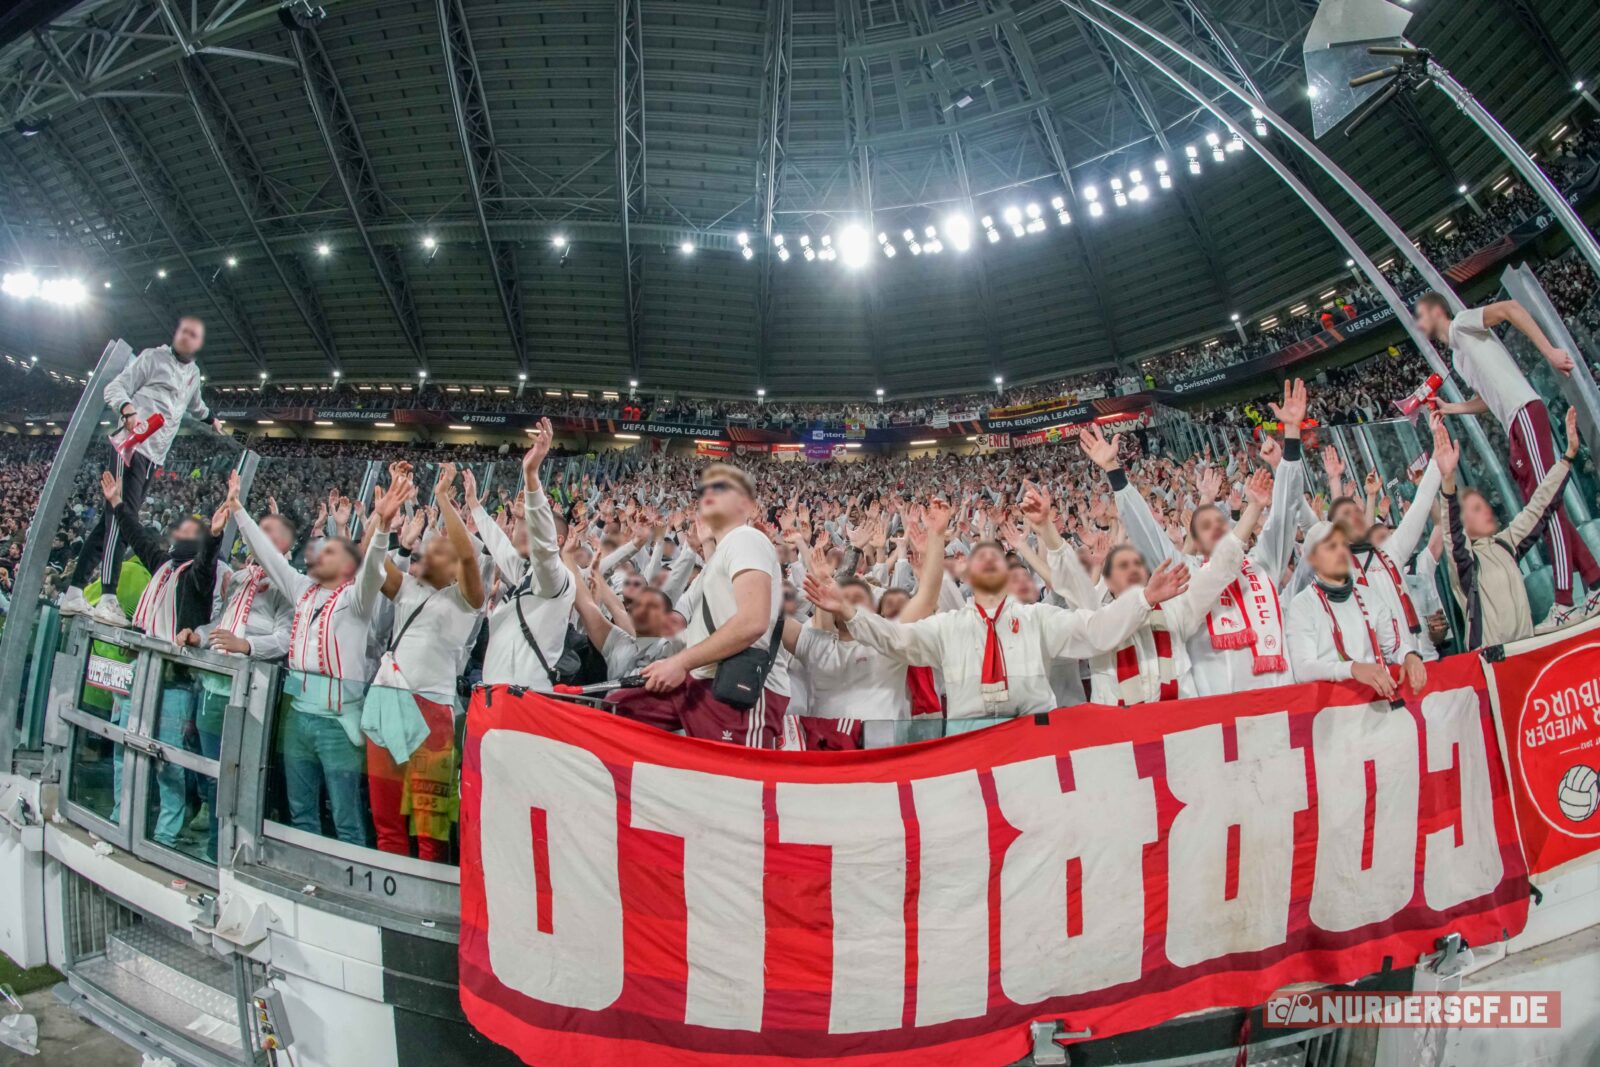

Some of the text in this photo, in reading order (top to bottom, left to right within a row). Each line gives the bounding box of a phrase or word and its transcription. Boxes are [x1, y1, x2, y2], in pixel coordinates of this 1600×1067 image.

[1346, 319, 1372, 333] UEFA
[1183, 373, 1226, 390] Swissquote
[470, 415, 507, 423] STRAUSS
[988, 407, 1088, 429] UEFA EUROPA LEAGUE
[622, 423, 720, 436] UEFA EUROPA LEAGUE
[1525, 713, 1588, 748] WIEDER
[479, 684, 1504, 1036] CORRILLO
[344, 865, 397, 897] 110
